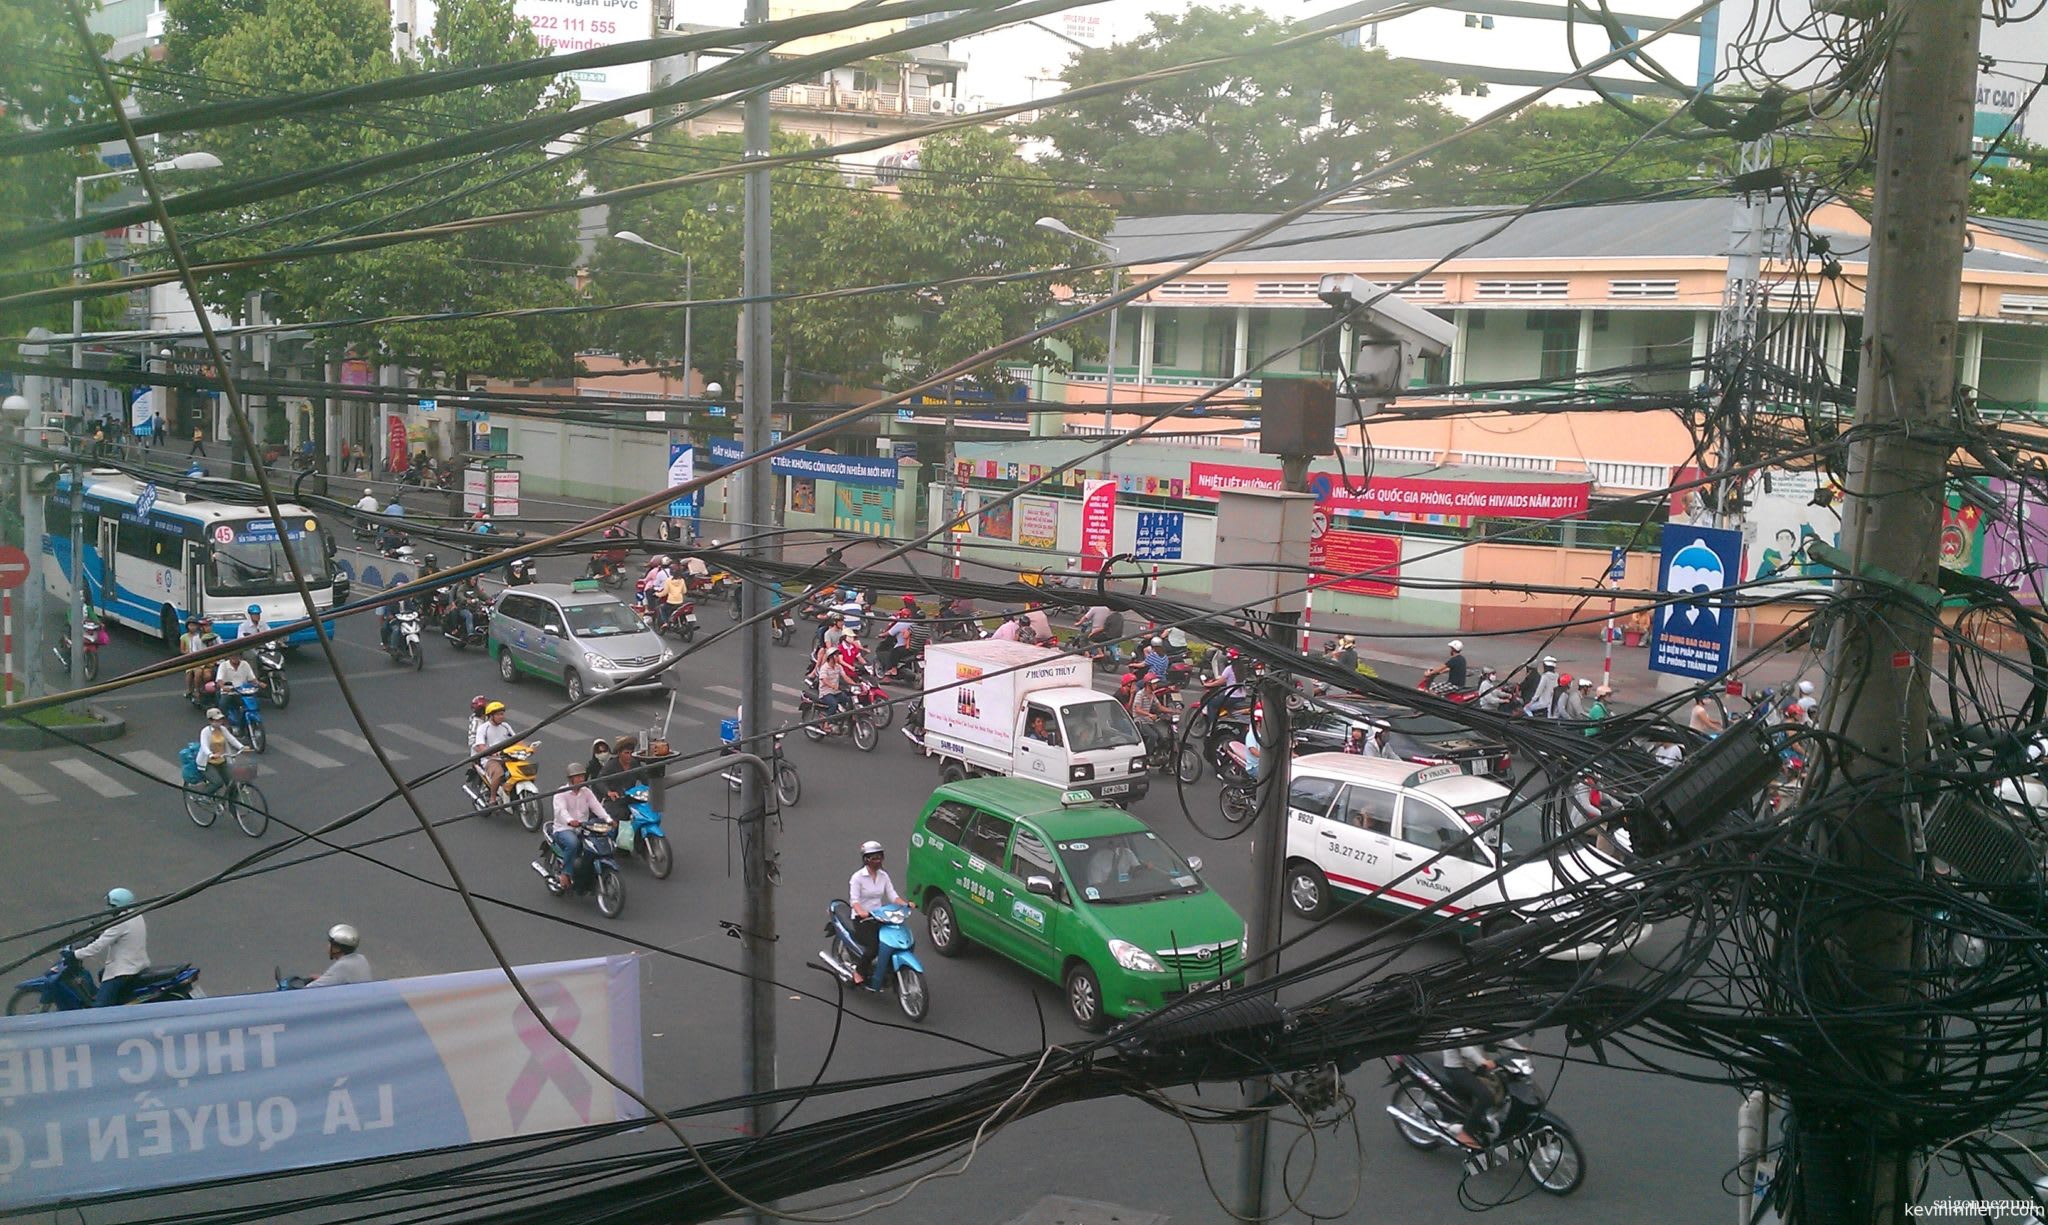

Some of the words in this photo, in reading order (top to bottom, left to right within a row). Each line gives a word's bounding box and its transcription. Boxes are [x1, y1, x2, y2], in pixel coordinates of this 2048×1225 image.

[562, 18, 585, 32] 111
[591, 20, 616, 34] 555
[792, 457, 813, 471] KHÔNG
[813, 460, 826, 473] CÒN
[880, 467, 892, 478] HIV
[1377, 486, 1402, 503] QUỐC
[1404, 489, 1419, 503] GIA
[1420, 490, 1453, 507] PHÒNG,
[1455, 490, 1486, 507] CHỐNG
[1488, 495, 1528, 508] HIV/AIDS
[1528, 493, 1551, 508] NĂM
[1551, 496, 1573, 508] 2011
[217, 527, 231, 542] 45
[1679, 646, 1695, 657] PHÁP
[1695, 650, 1704, 659] AN
[1704, 651, 1719, 662] TOÀN
[1666, 655, 1687, 668] PHÒNG
[1687, 660, 1707, 672] TRÁNH
[1707, 664, 1718, 673] HIV
[1068, 791, 1091, 801] TAXI
[1328, 841, 1354, 858] 38.27
[1354, 850, 1366, 862] 27
[1366, 853, 1378, 865] 27
[1415, 877, 1452, 893] VINASUN
